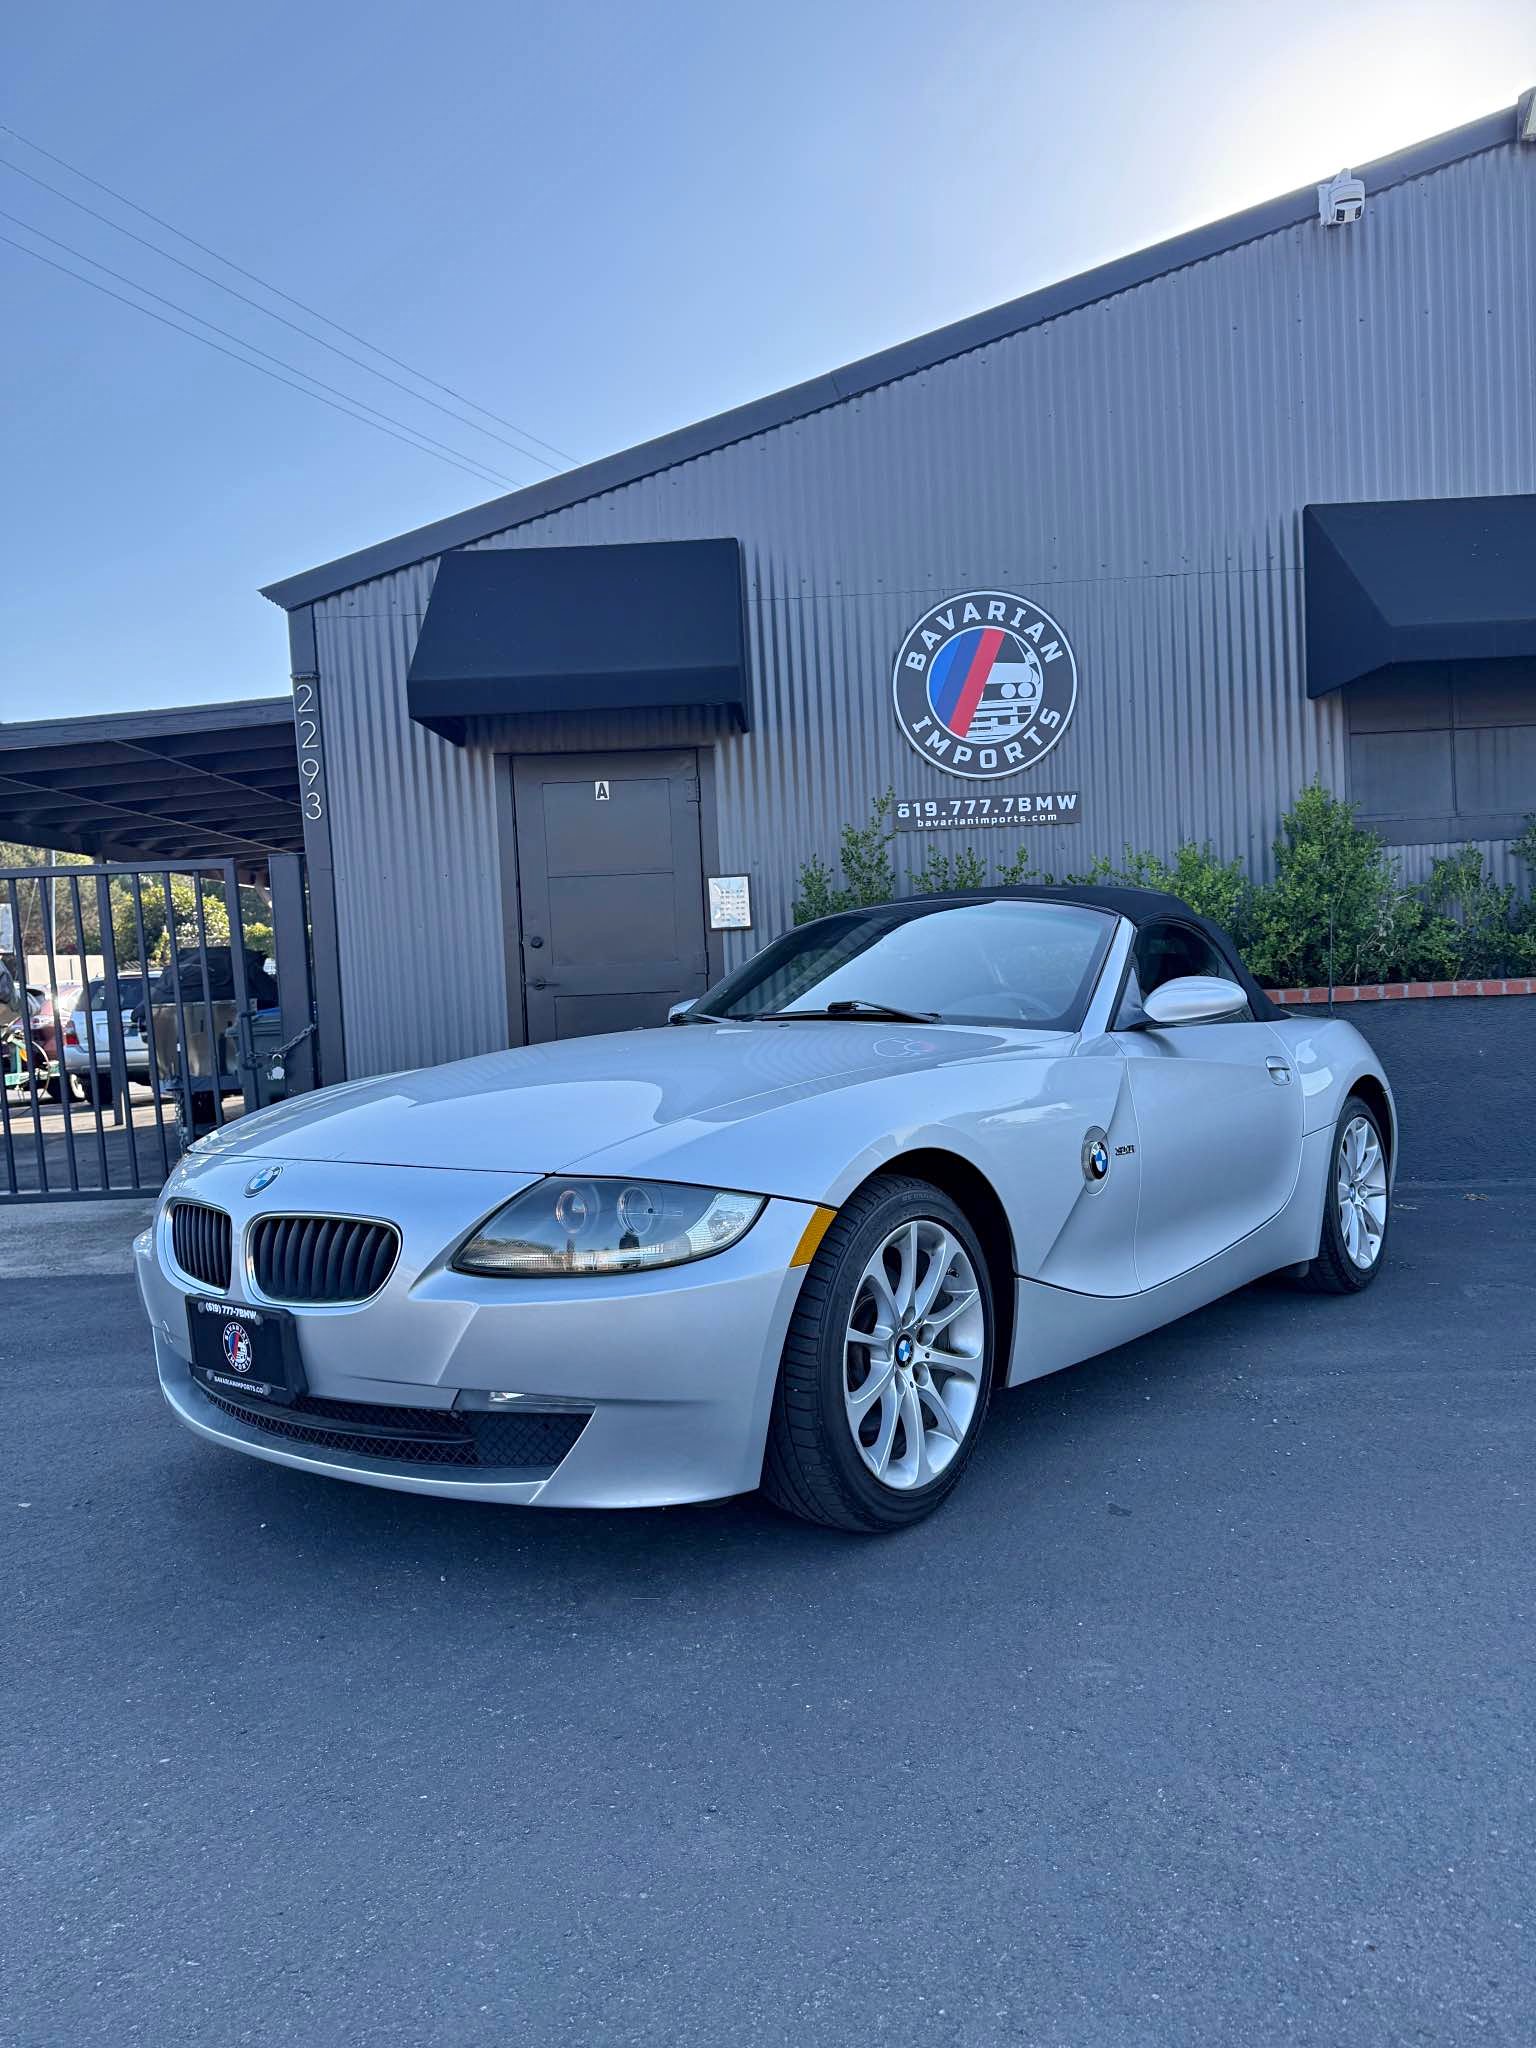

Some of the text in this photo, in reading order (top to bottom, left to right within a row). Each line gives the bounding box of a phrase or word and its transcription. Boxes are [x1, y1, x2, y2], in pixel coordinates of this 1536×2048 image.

[905, 600, 1063, 672] BAVARIAN
[296, 684, 322, 820] 2293
[912, 708, 1061, 769] IMPORTS
[596, 782, 608, 799] A
[897, 794, 1077, 818] 619.777.7BMW
[917, 813, 1058, 828] bavarianimports.com
